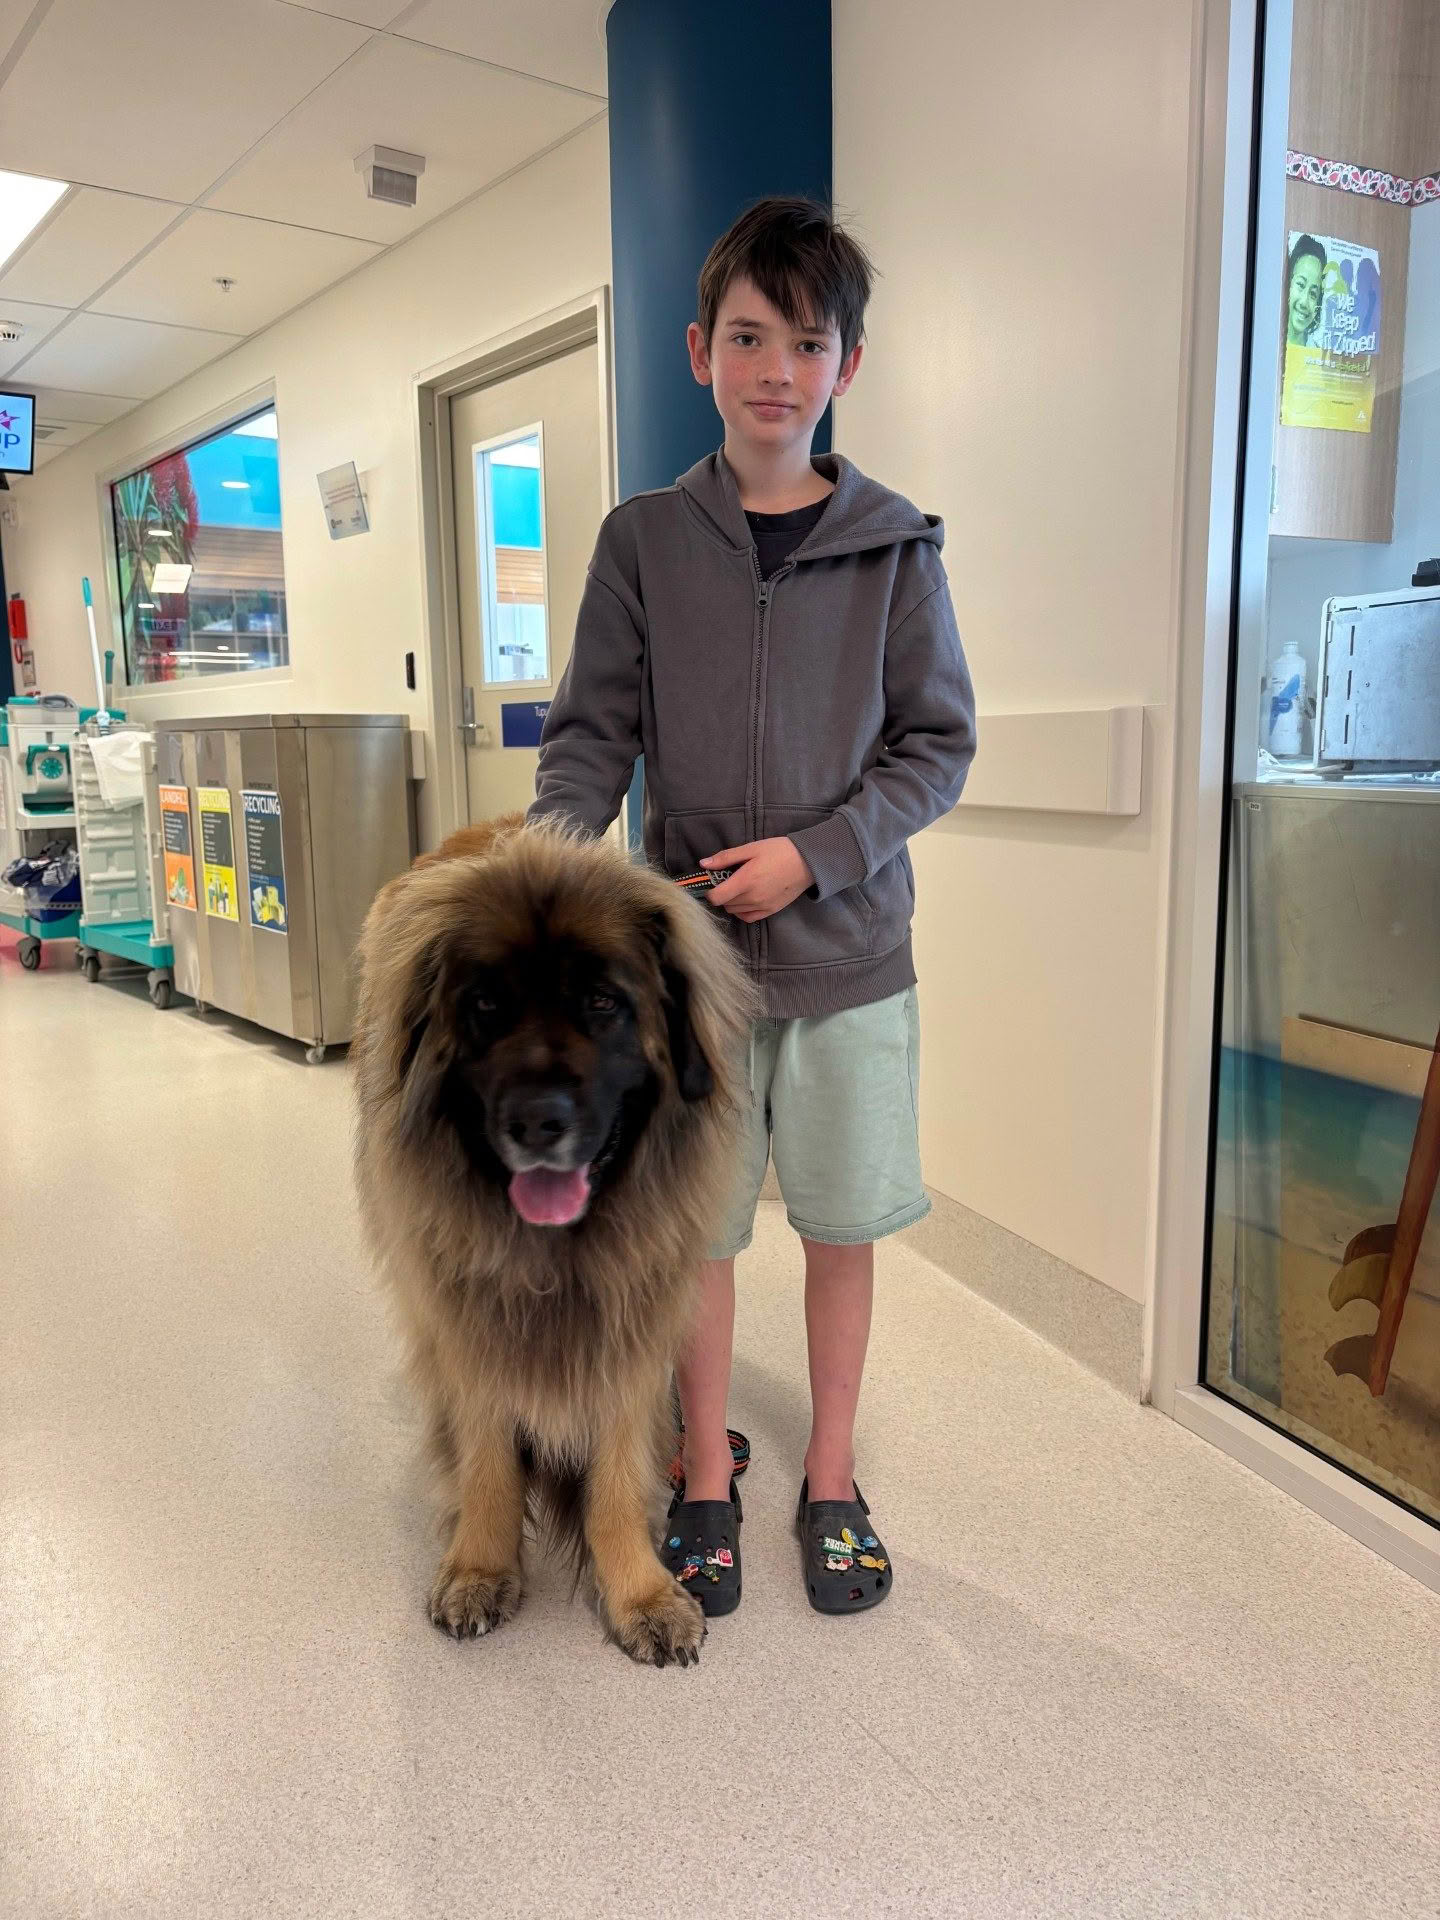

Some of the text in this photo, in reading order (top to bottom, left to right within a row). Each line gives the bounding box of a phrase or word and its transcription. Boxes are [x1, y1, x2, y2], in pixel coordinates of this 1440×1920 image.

[1337, 293, 1355, 313] We
[1332, 310, 1360, 335] keep
[244, 797, 280, 815] RECYCLING
